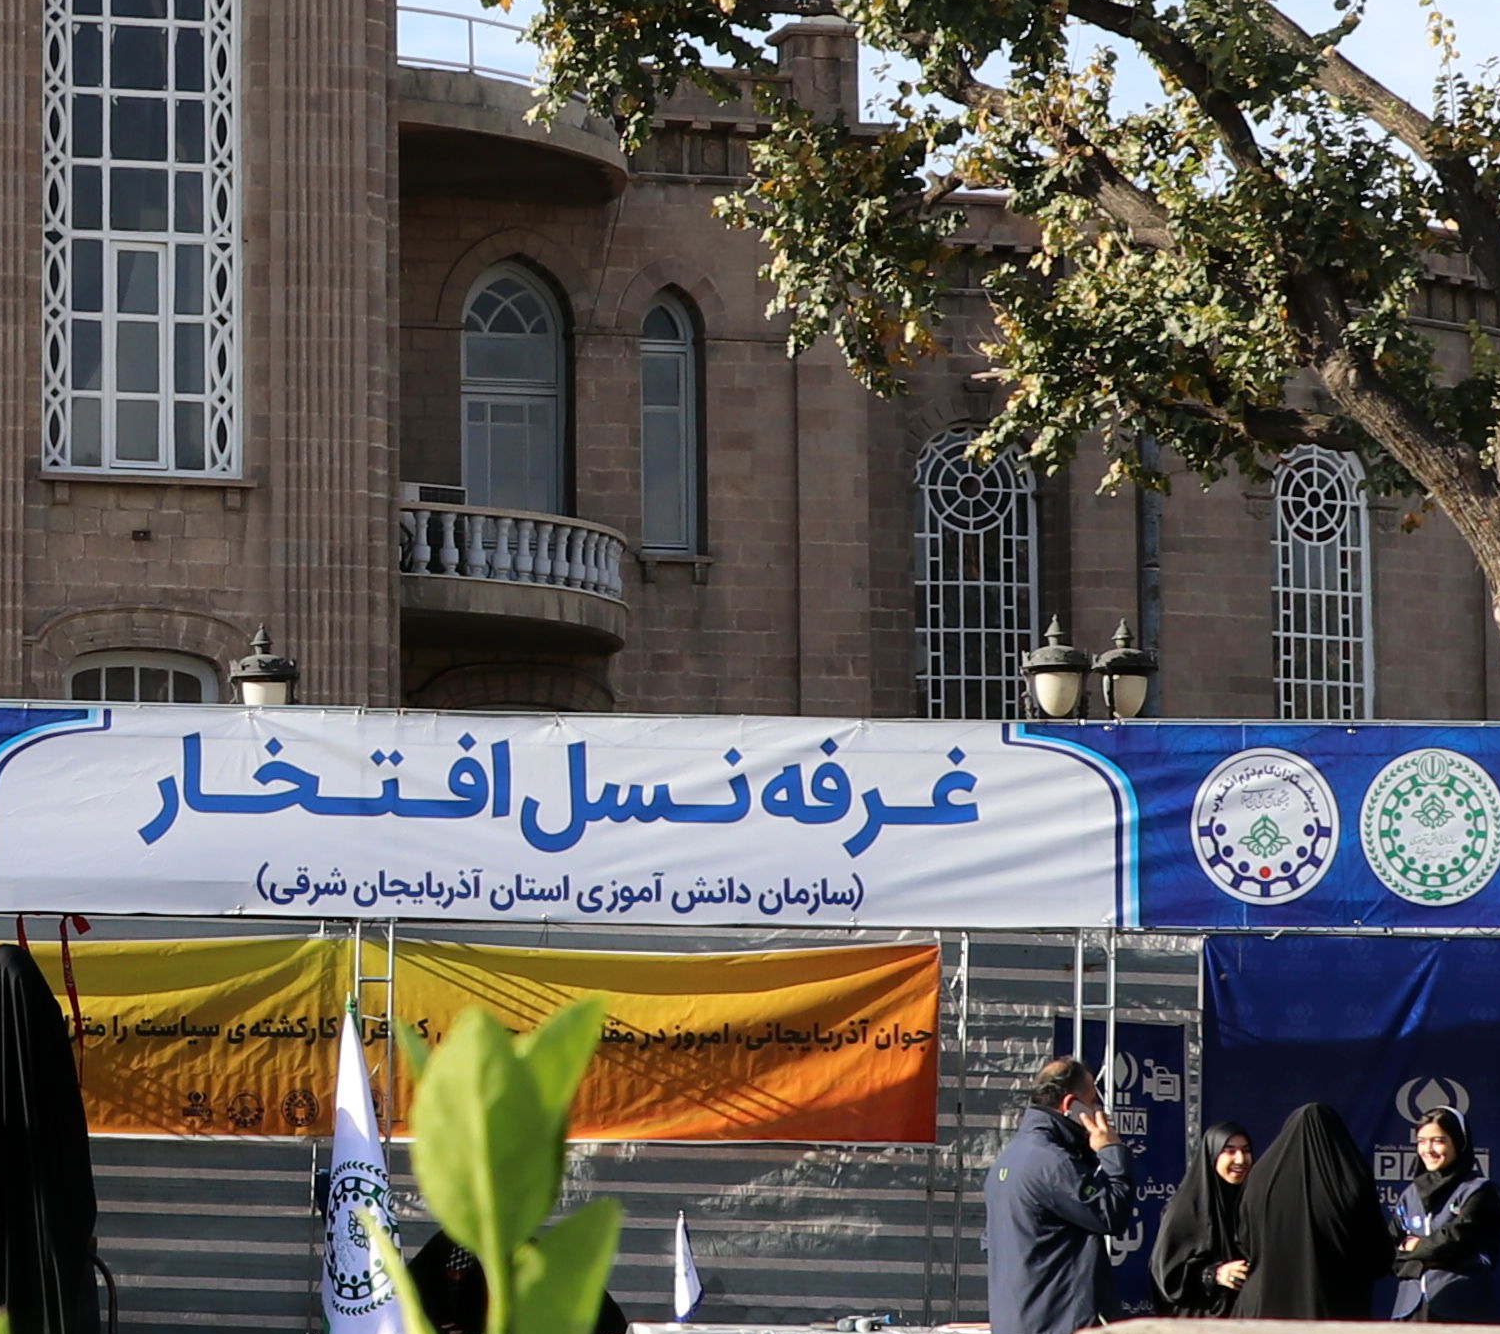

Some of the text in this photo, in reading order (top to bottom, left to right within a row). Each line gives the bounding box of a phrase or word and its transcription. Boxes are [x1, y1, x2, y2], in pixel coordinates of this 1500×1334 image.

[137, 731, 980, 859] غرفه نسل افتخار
[256, 862, 865, 916] (سازمان دانش آموزی استان آذربایجان شرقی)
[112, 1016, 129, 1044] را
[134, 1015, 220, 1046] سیاست
[642, 1025, 667, 1051] در
[671, 1021, 732, 1051] امروز
[736, 1018, 869, 1053] آذربایجانی،
[875, 1022, 935, 1053] جوان
